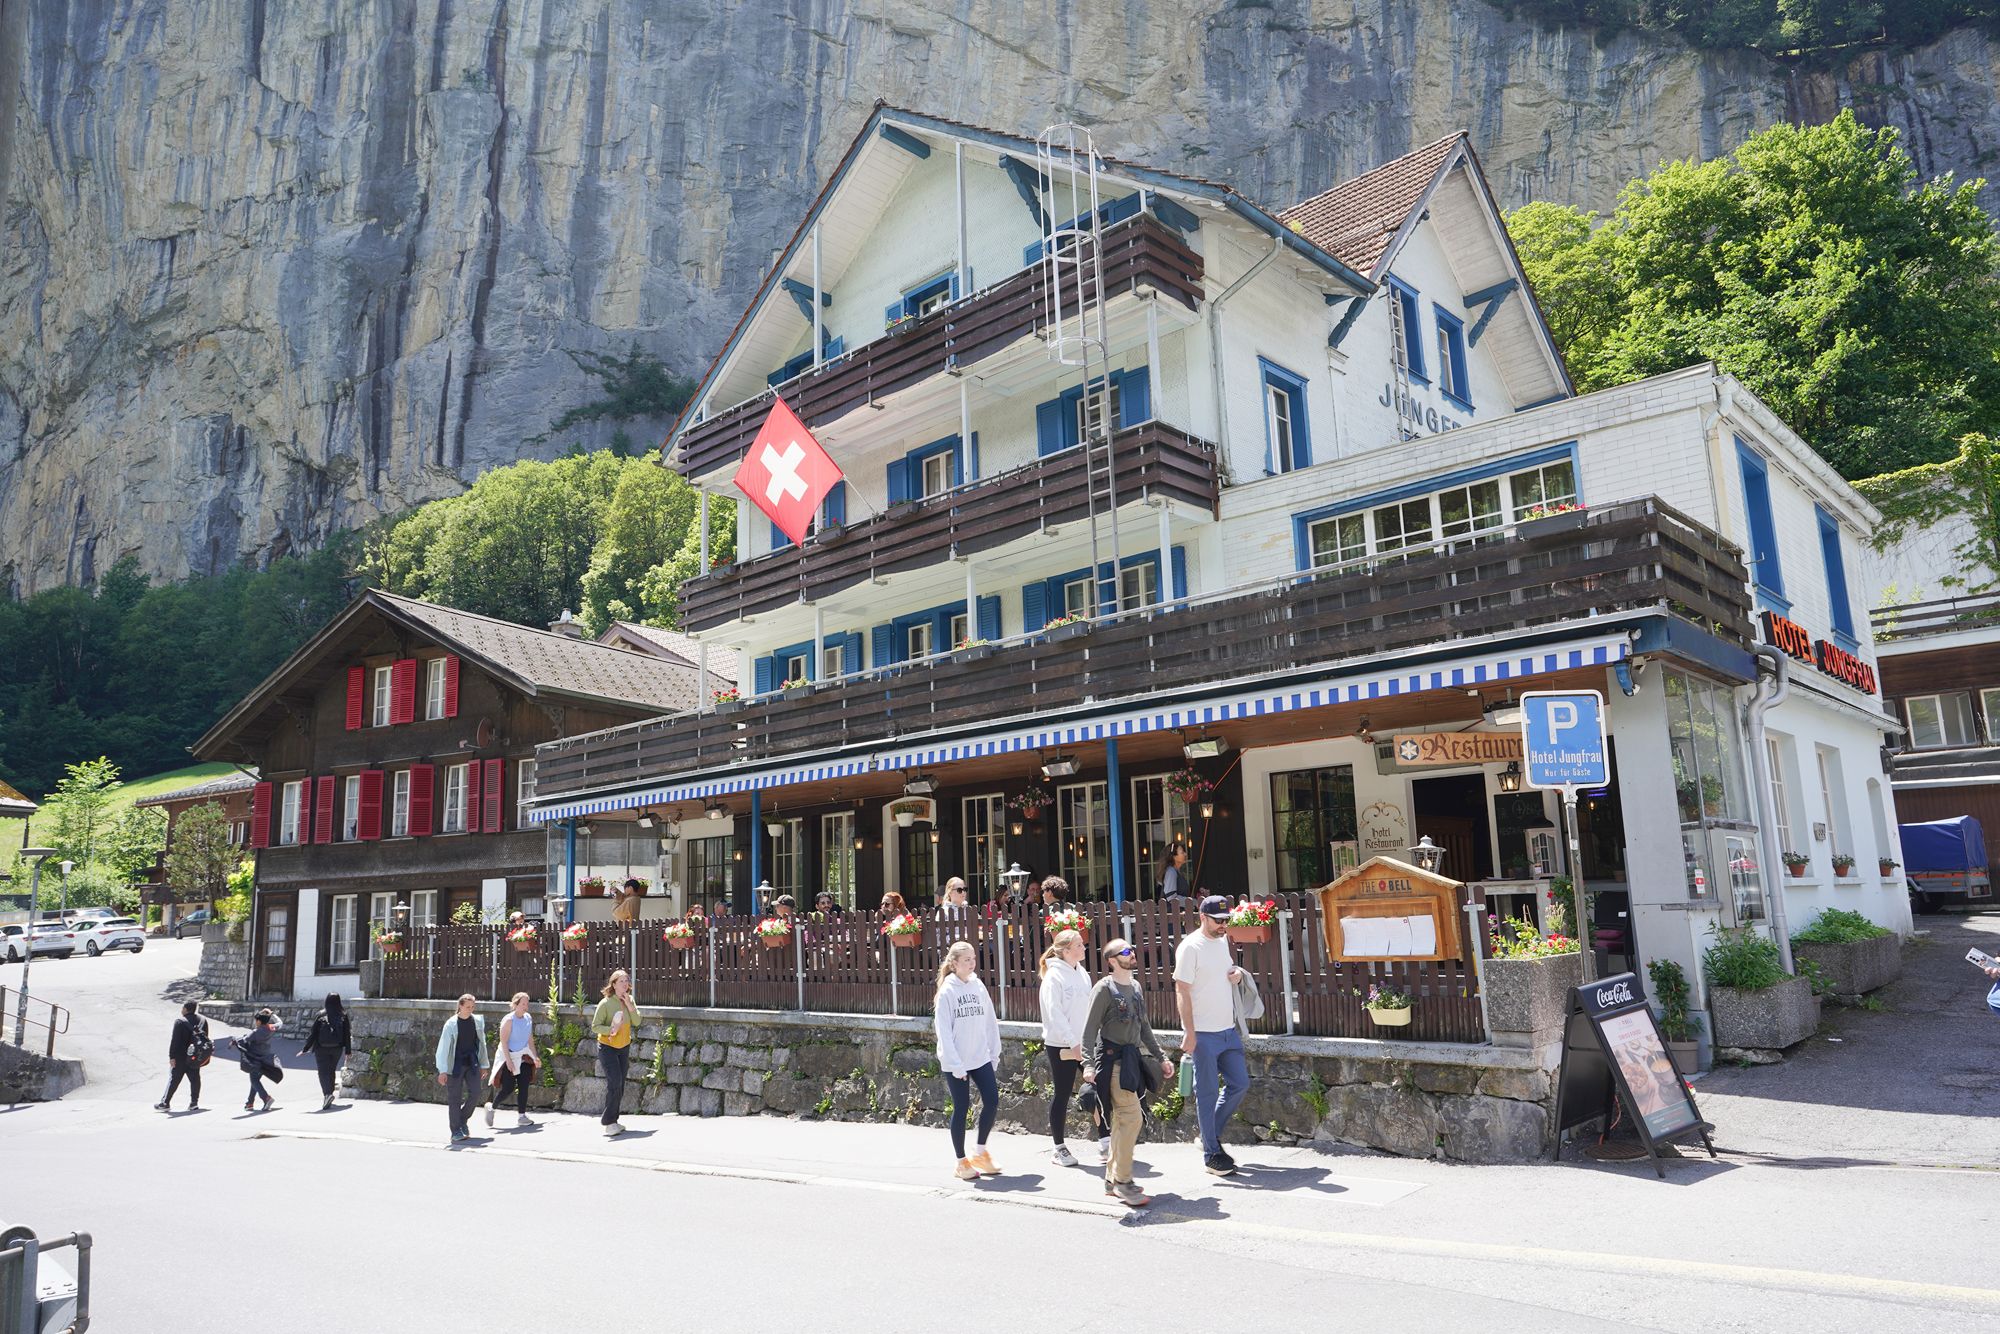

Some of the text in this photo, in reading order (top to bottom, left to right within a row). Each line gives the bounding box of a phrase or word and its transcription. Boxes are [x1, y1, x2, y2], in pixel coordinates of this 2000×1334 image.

[1770, 611, 1877, 694] HOTEL JUNGFRAU
[1546, 701, 1578, 745] P
[1531, 749, 1602, 767] Hotel Jungfrau
[1544, 768, 1557, 777] Nur
[1365, 836, 1405, 849] Restaurant
[1360, 879, 1412, 893] THE BELL
